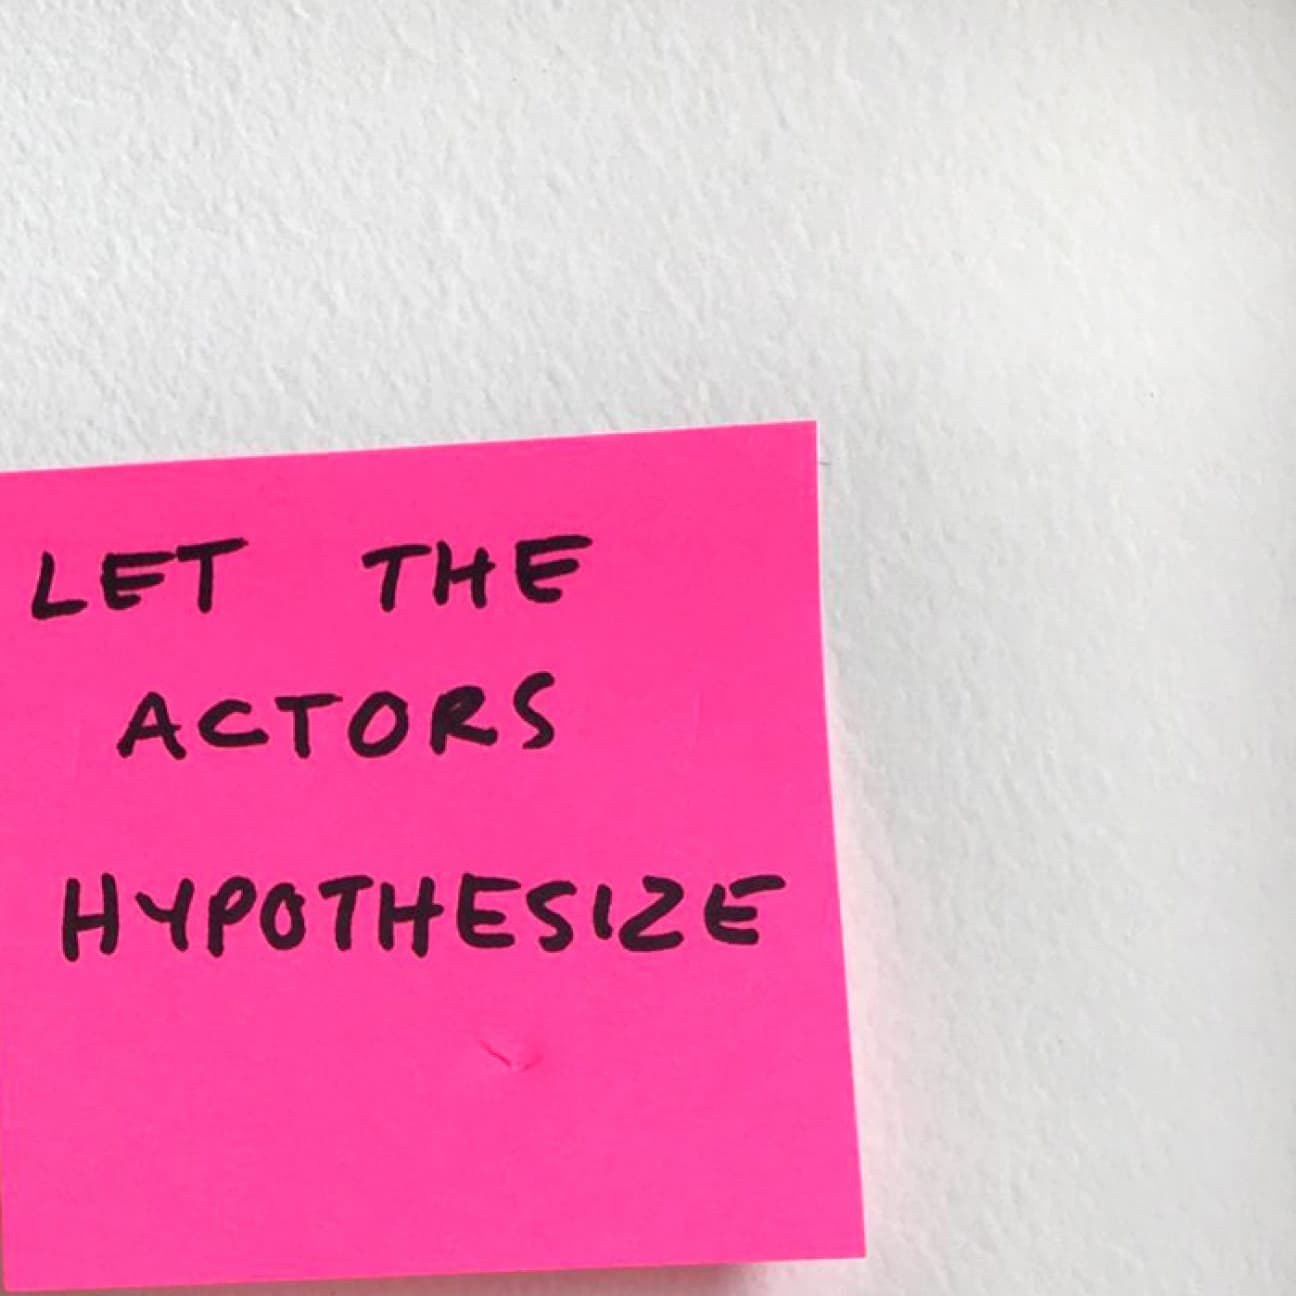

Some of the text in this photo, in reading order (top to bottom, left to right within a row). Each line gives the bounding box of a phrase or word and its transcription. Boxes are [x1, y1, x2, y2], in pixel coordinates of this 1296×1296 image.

[31, 534, 593, 620] LET THE
[116, 671, 555, 760] ACTORS
[62, 872, 786, 962] HYPOTHESIZE
